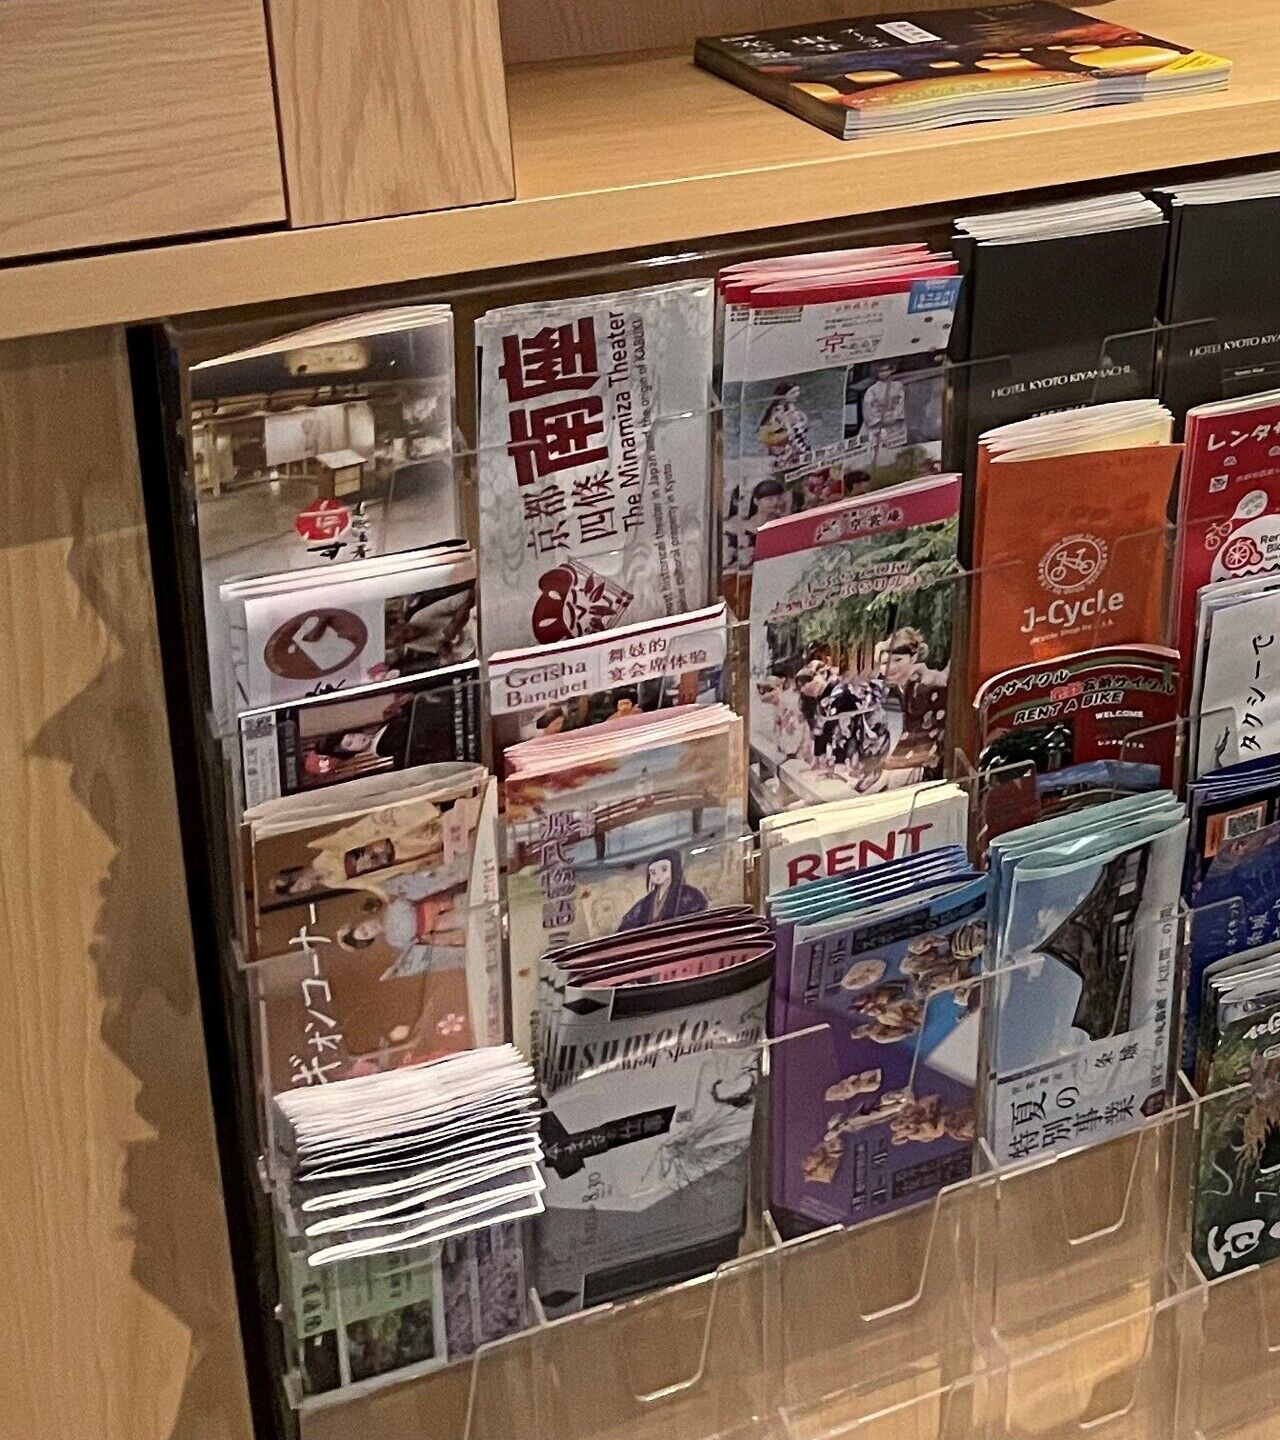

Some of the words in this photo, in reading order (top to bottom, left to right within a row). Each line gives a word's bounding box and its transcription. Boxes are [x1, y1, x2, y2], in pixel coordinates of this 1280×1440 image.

[606, 311, 631, 389] Theater
[1188, 341, 1222, 358] HOTEL
[1223, 336, 1260, 352] KYOTO
[498, 316, 609, 487] 南座
[991, 382, 1026, 400] HOTEL
[1028, 375, 1069, 394] KYOTO
[1069, 364, 1132, 384] KIYAMACHI
[612, 390, 643, 489] Minamiza
[522, 483, 570, 554] 京都
[621, 492, 645, 532] The
[1020, 588, 1125, 633] J-Cycle
[505, 660, 587, 689] Geisha
[506, 678, 587, 709] Banquet
[1012, 702, 1063, 726] RENT
[1063, 697, 1078, 713] A
[1080, 689, 1125, 709] BIKE
[1095, 709, 1144, 720] WELCOME
[786, 822, 934, 889] RENT
[1008, 1094, 1136, 1159] 特別事業
[1010, 1086, 1080, 1133] 夏の
